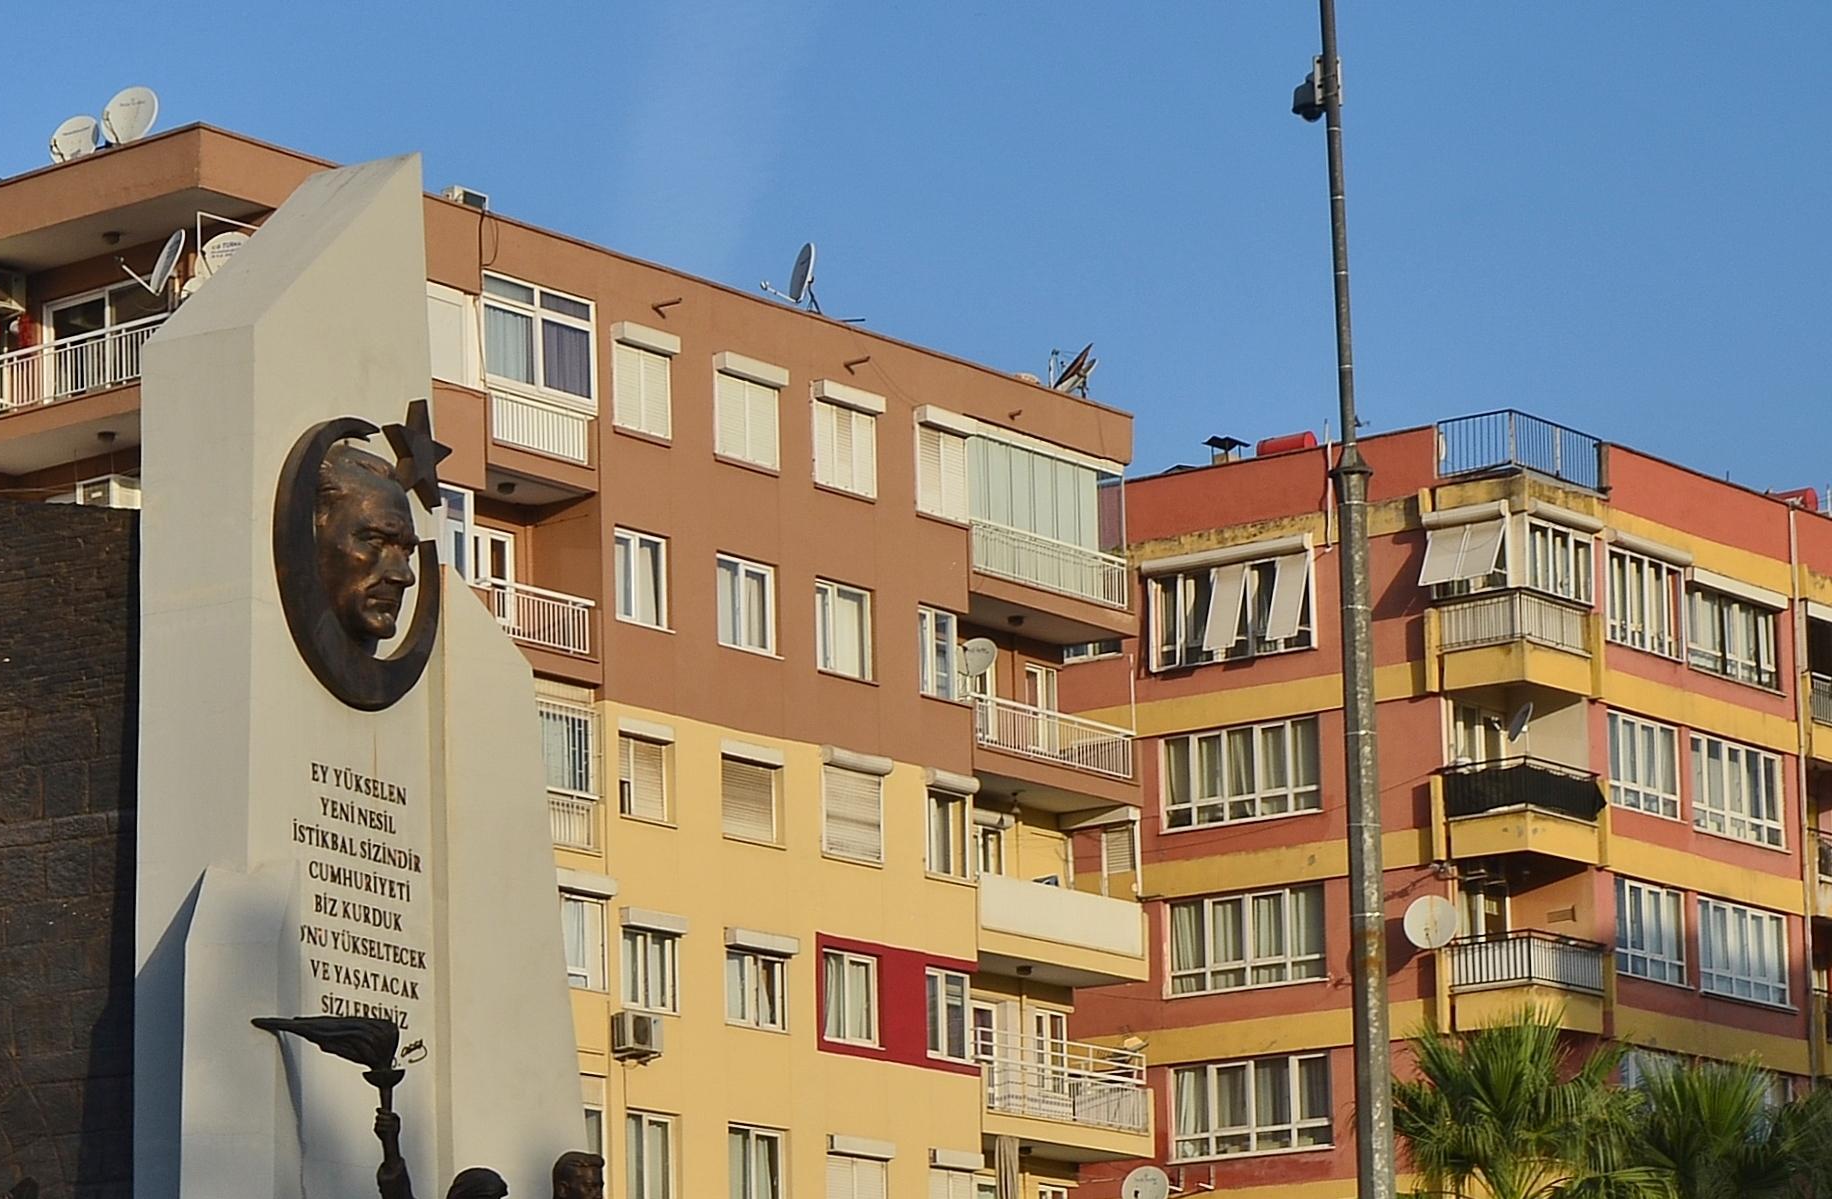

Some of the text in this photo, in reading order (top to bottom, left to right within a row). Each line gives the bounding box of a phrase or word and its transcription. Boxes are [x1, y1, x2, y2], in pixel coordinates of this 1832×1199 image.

[311, 762, 407, 806] EY YÜKSELEN
[320, 796, 397, 834] YENİ NESİL
[292, 818, 422, 873] İSTİKBAL SİZİNDİR
[308, 861, 411, 903] CUMHURİYETİ
[314, 892, 403, 932] BİZ KURDUK
[331, 929, 427, 970] YÜKSELTECEK
[310, 959, 420, 1000] VE YAŞATACAK
